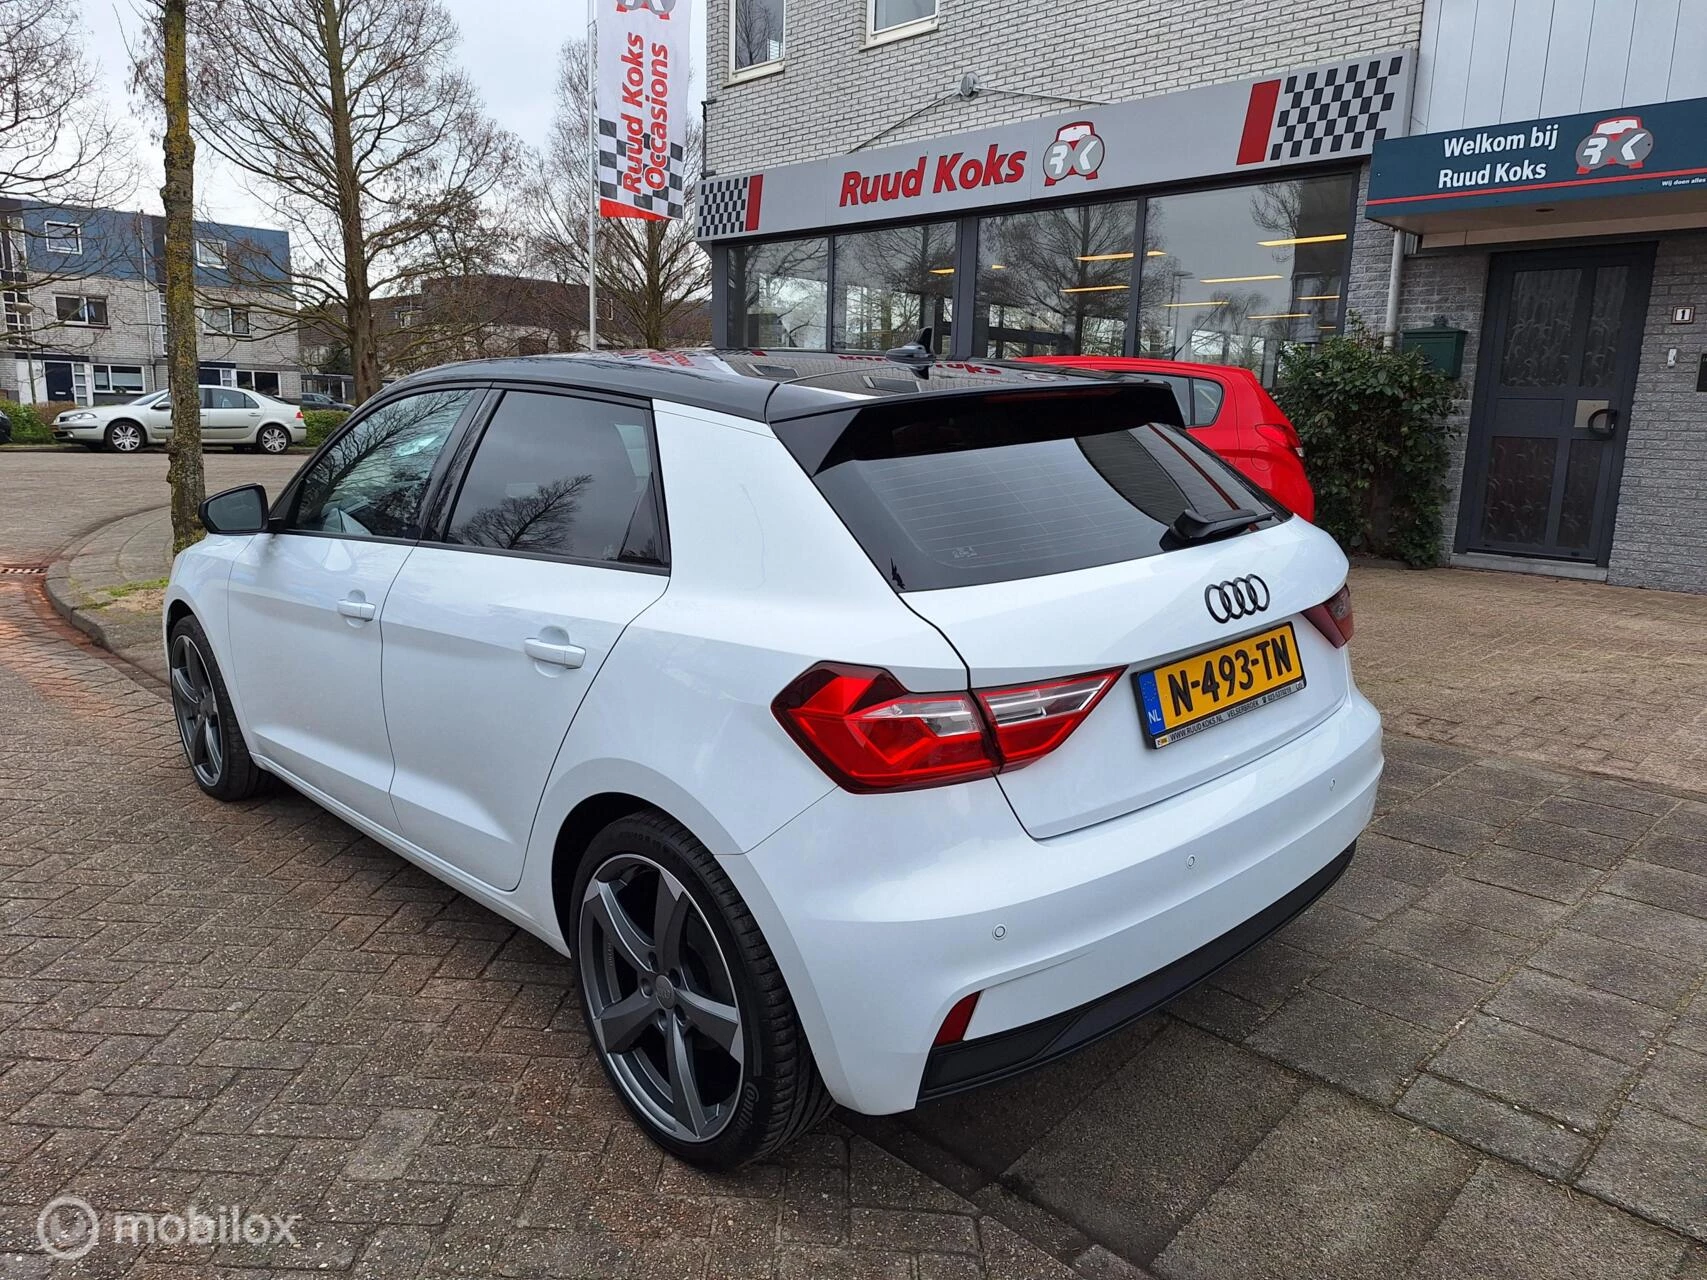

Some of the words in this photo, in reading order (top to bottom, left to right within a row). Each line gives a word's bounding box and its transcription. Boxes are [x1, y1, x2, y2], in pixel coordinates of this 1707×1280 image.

[620, 32, 644, 109] Koks
[644, 42, 668, 191] Occasions
[1443, 131, 1525, 158] Welkom
[1530, 125, 1559, 149] bij
[620, 113, 644, 194] Ruud
[839, 154, 928, 207] Ruud
[932, 143, 1027, 193] Koks
[1437, 164, 1492, 188] Ruud
[1494, 160, 1547, 183] Koks
[1168, 634, 1292, 716] N-493-TN
[1148, 709, 1161, 724] NL
